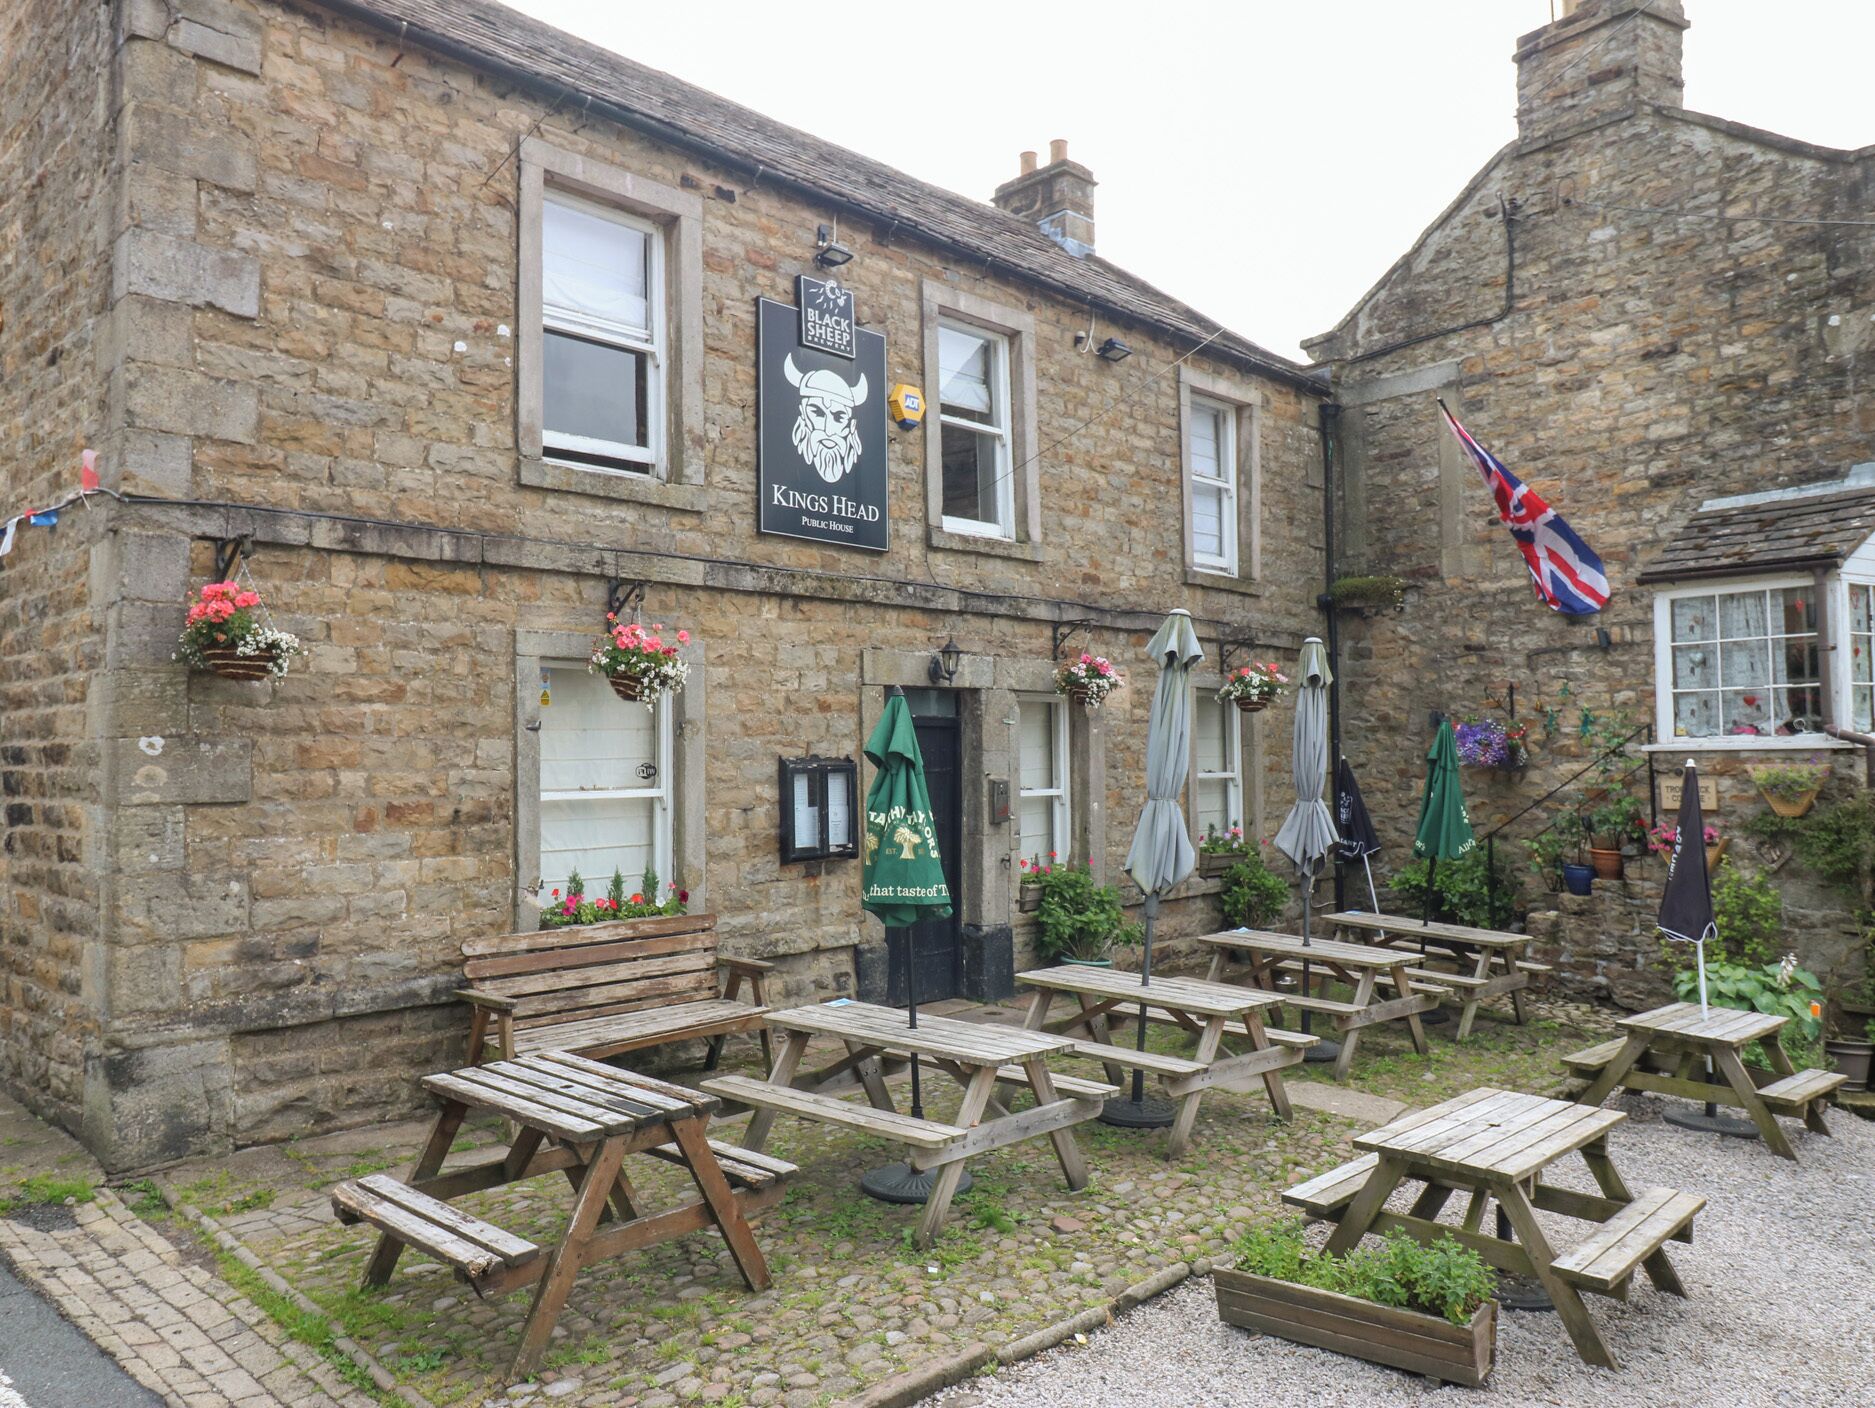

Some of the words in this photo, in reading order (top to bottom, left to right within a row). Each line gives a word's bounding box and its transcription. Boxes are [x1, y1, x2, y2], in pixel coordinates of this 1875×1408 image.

[807, 308, 850, 333] BLACK
[807, 322, 850, 345] SHEEP
[807, 335, 850, 352] BREWERY
[904, 394, 919, 411] ADT
[869, 883, 895, 897] that
[897, 885, 926, 897] taste
[926, 884, 938, 897] of
